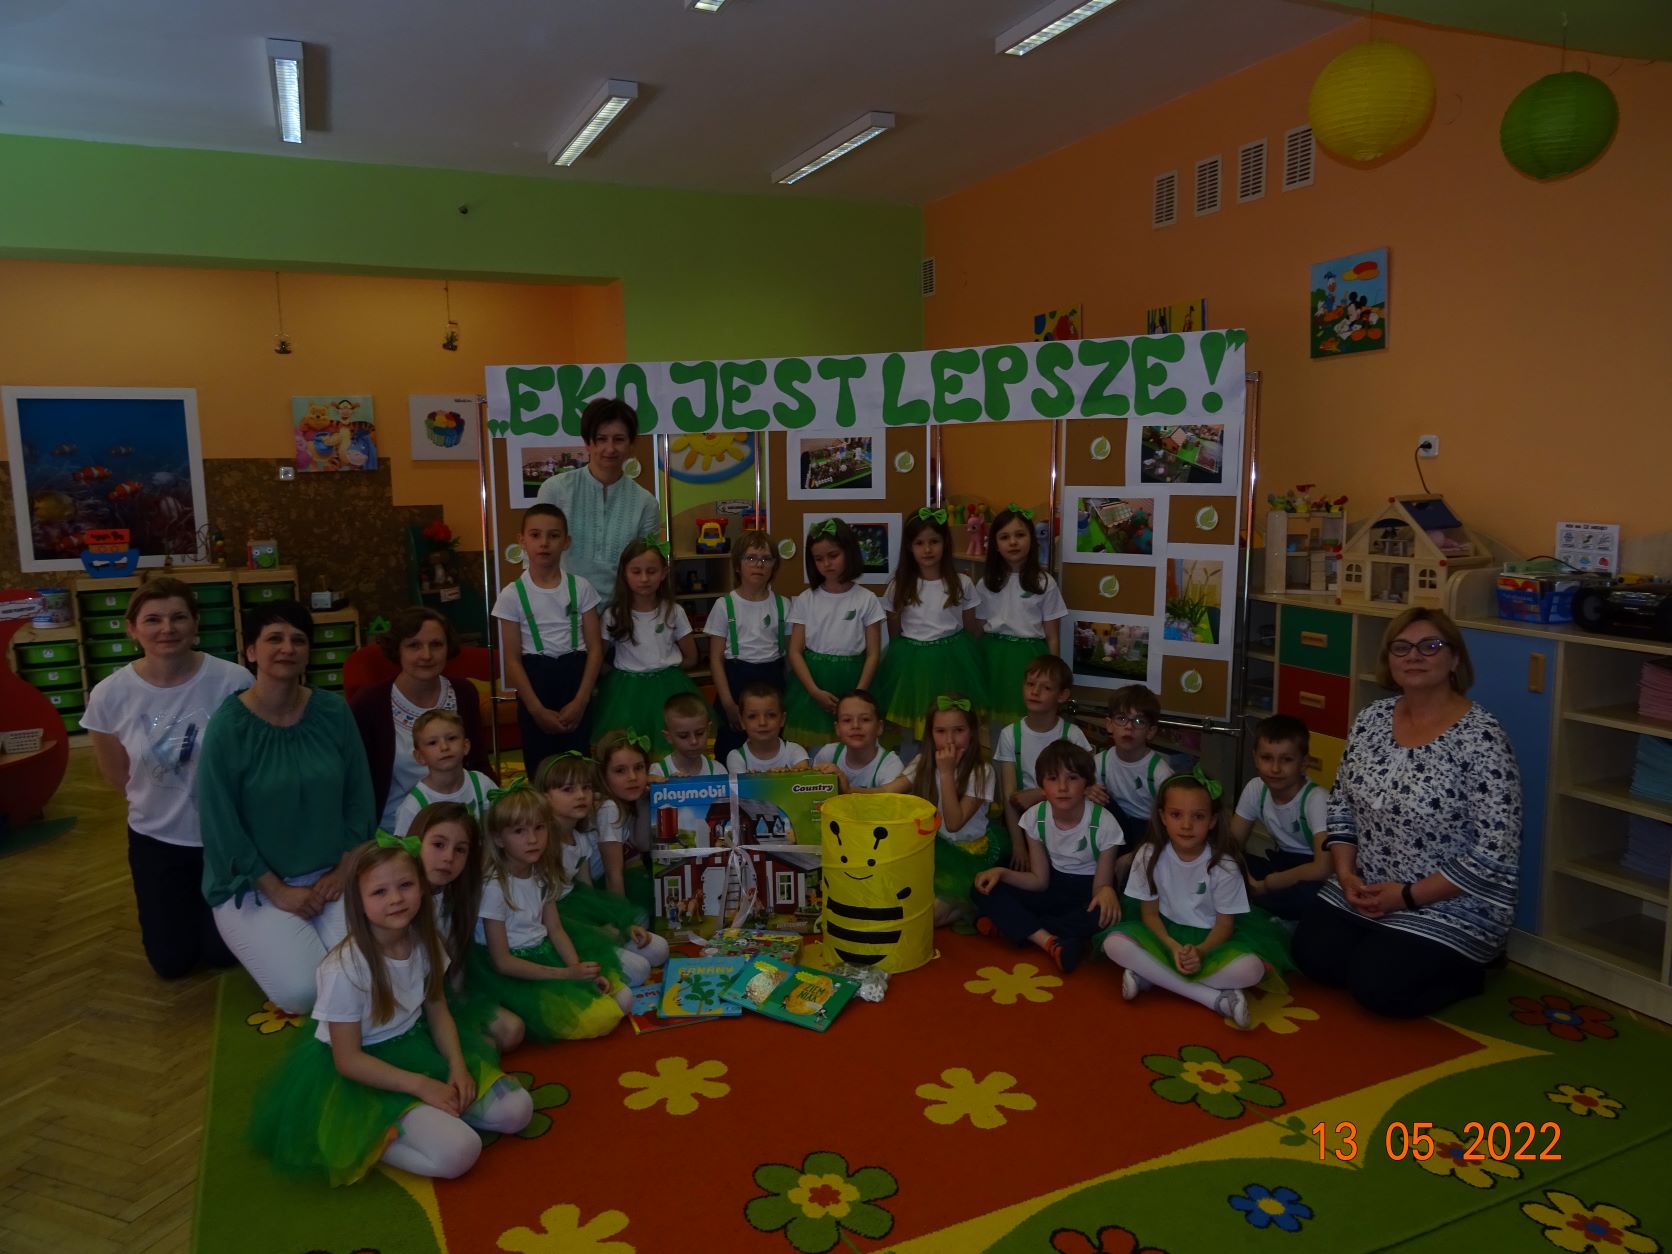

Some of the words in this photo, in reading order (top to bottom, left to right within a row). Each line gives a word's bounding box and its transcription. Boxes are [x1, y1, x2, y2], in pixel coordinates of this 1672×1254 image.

[669, 356, 867, 432] JEST
[653, 784, 727, 804] playmobil
[792, 783, 834, 795] Country
